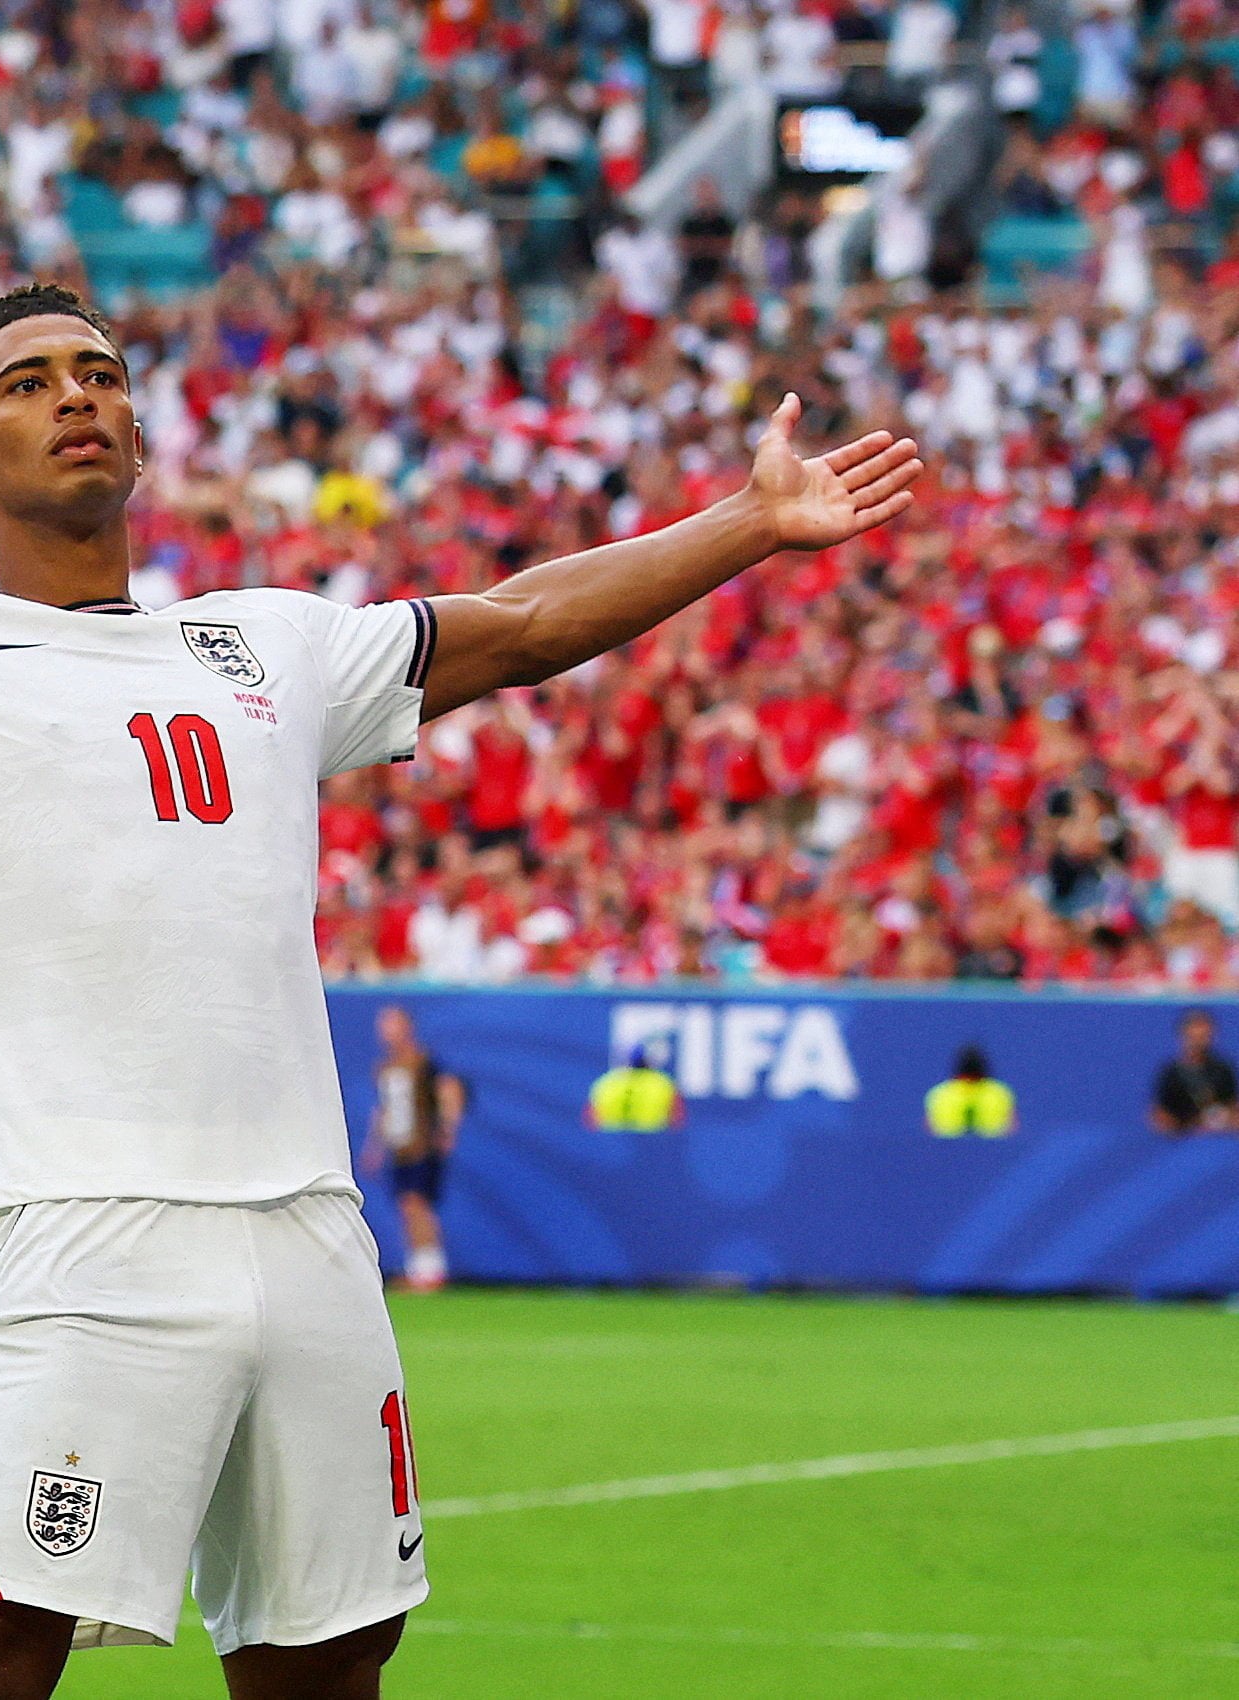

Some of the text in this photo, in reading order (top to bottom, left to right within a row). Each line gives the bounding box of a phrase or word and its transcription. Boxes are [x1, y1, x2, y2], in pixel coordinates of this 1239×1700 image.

[233, 692, 275, 709] NORWAY
[126, 712, 233, 824] 10
[612, 1002, 859, 1100] FIFA
[380, 1389, 419, 1518] 1
